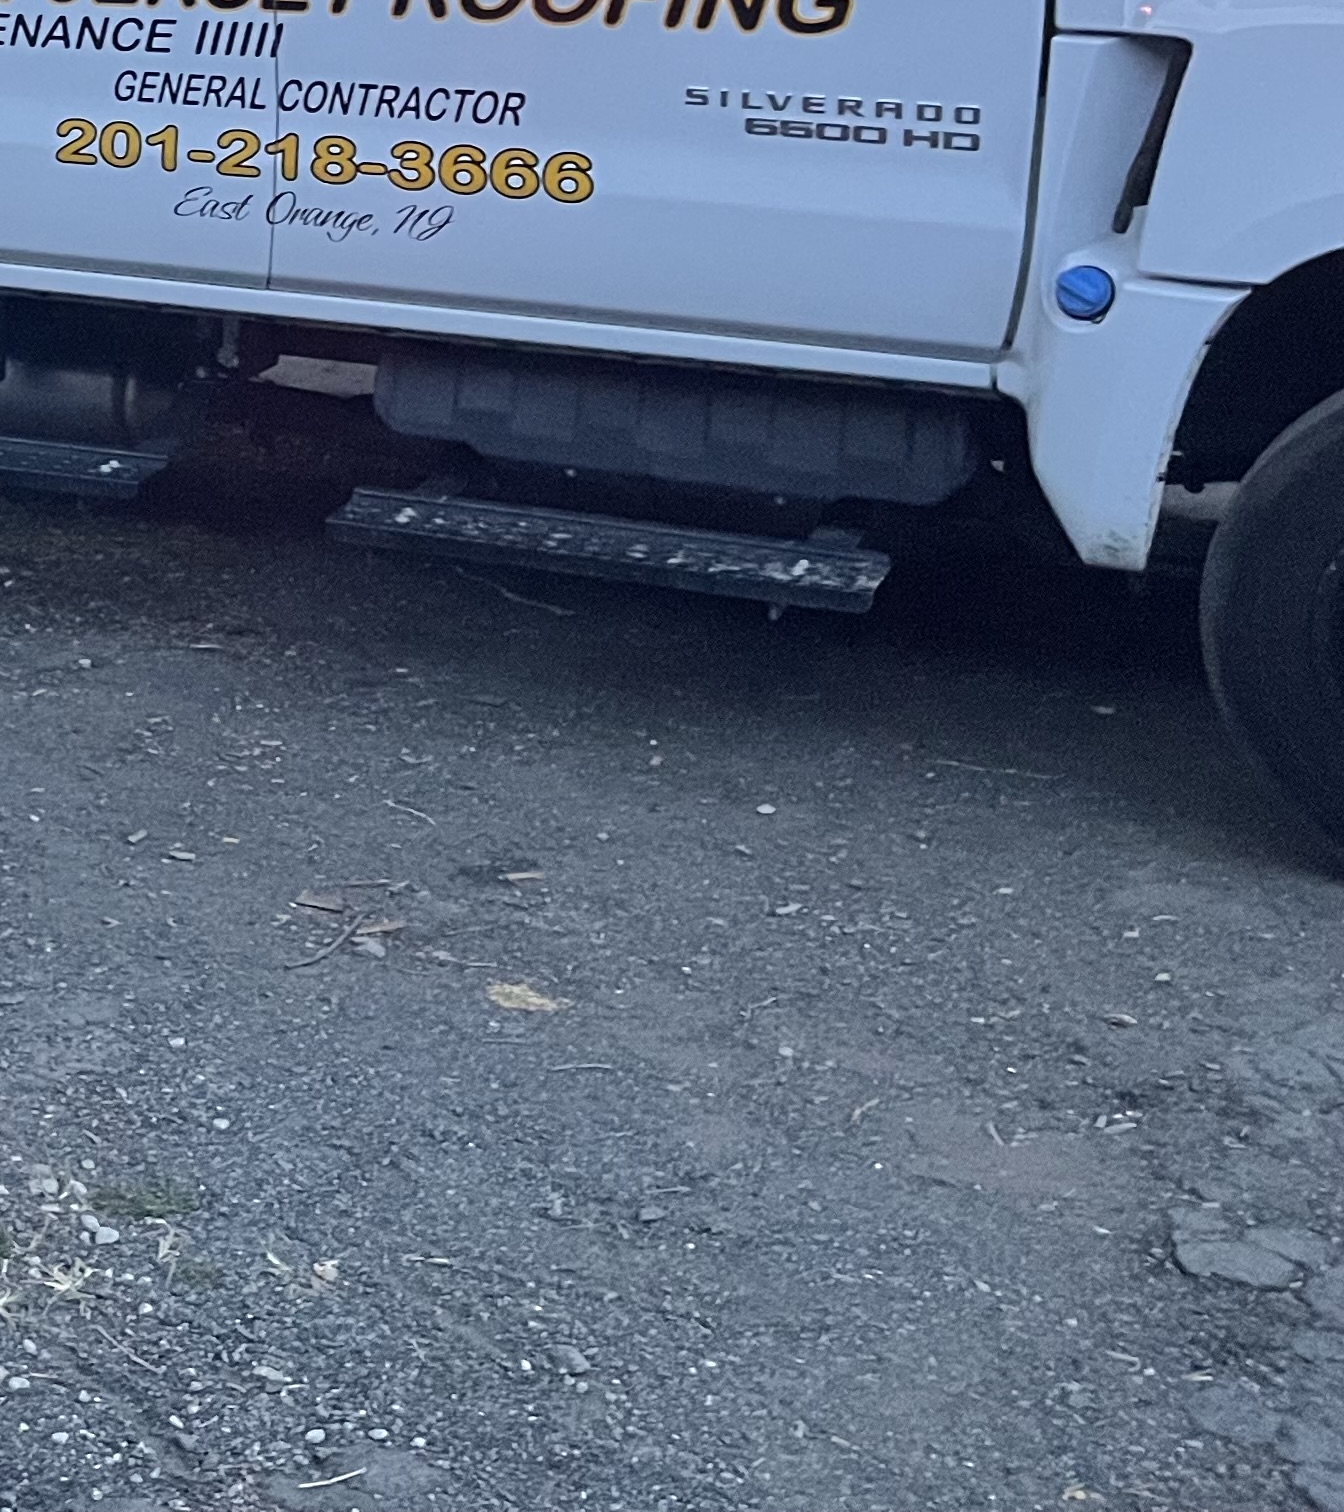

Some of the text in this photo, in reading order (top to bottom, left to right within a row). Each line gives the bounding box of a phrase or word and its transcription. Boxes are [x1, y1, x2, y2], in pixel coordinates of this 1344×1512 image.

[113, 69, 526, 127] GENERAL CONTRACTOR
[685, 87, 981, 125] SILVERADO
[54, 117, 595, 204] 201-218-3666
[903, 128, 981, 152] HD
[172, 186, 458, 243] East Orange, NJ
